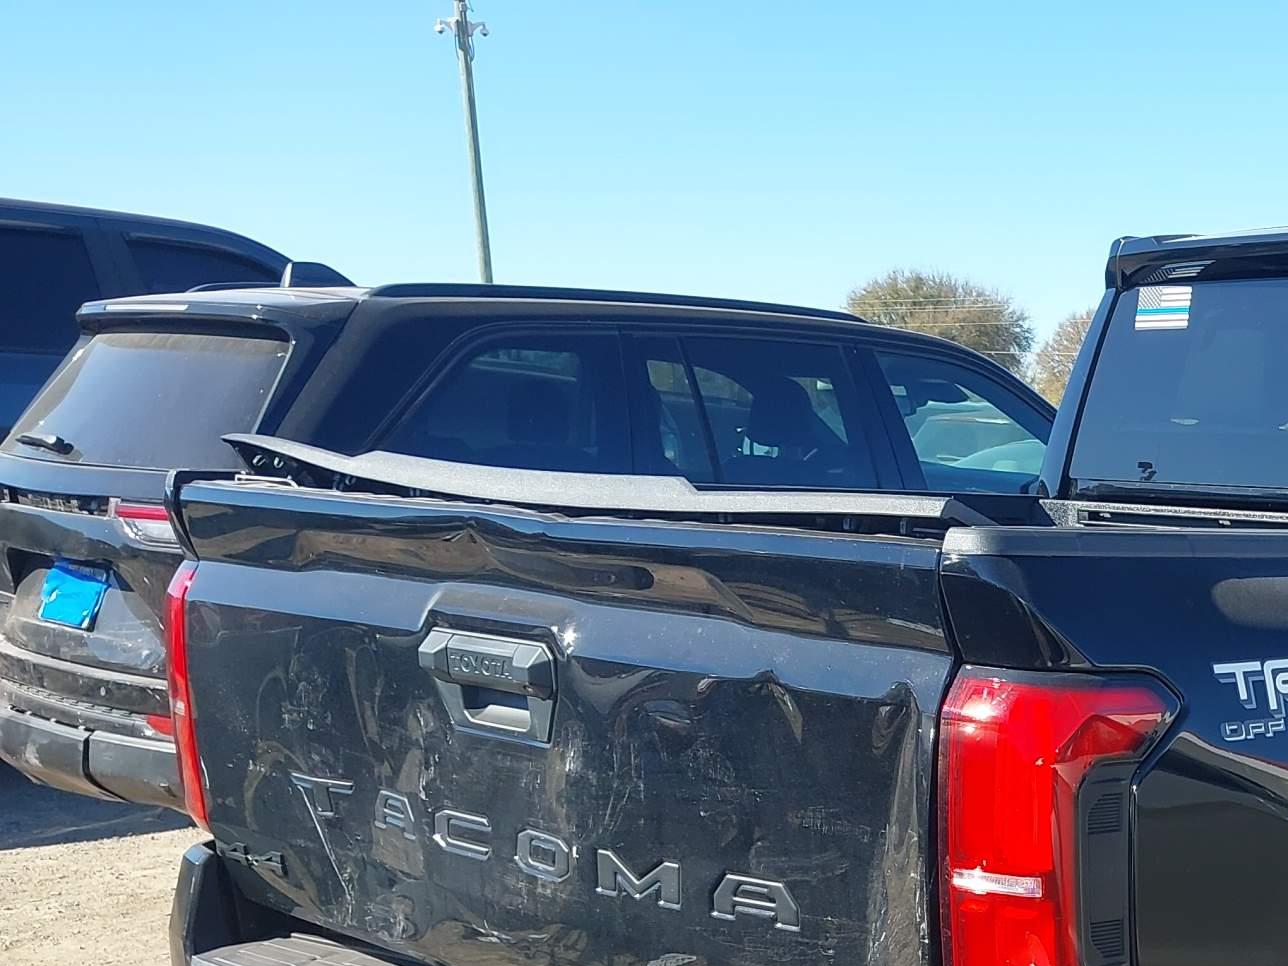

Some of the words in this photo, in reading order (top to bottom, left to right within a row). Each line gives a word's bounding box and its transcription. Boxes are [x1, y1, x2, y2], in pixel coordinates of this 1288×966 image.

[450, 654, 513, 679] TOYOTA
[1221, 718, 1285, 741] OFF
[290, 772, 801, 932] TACOMA
